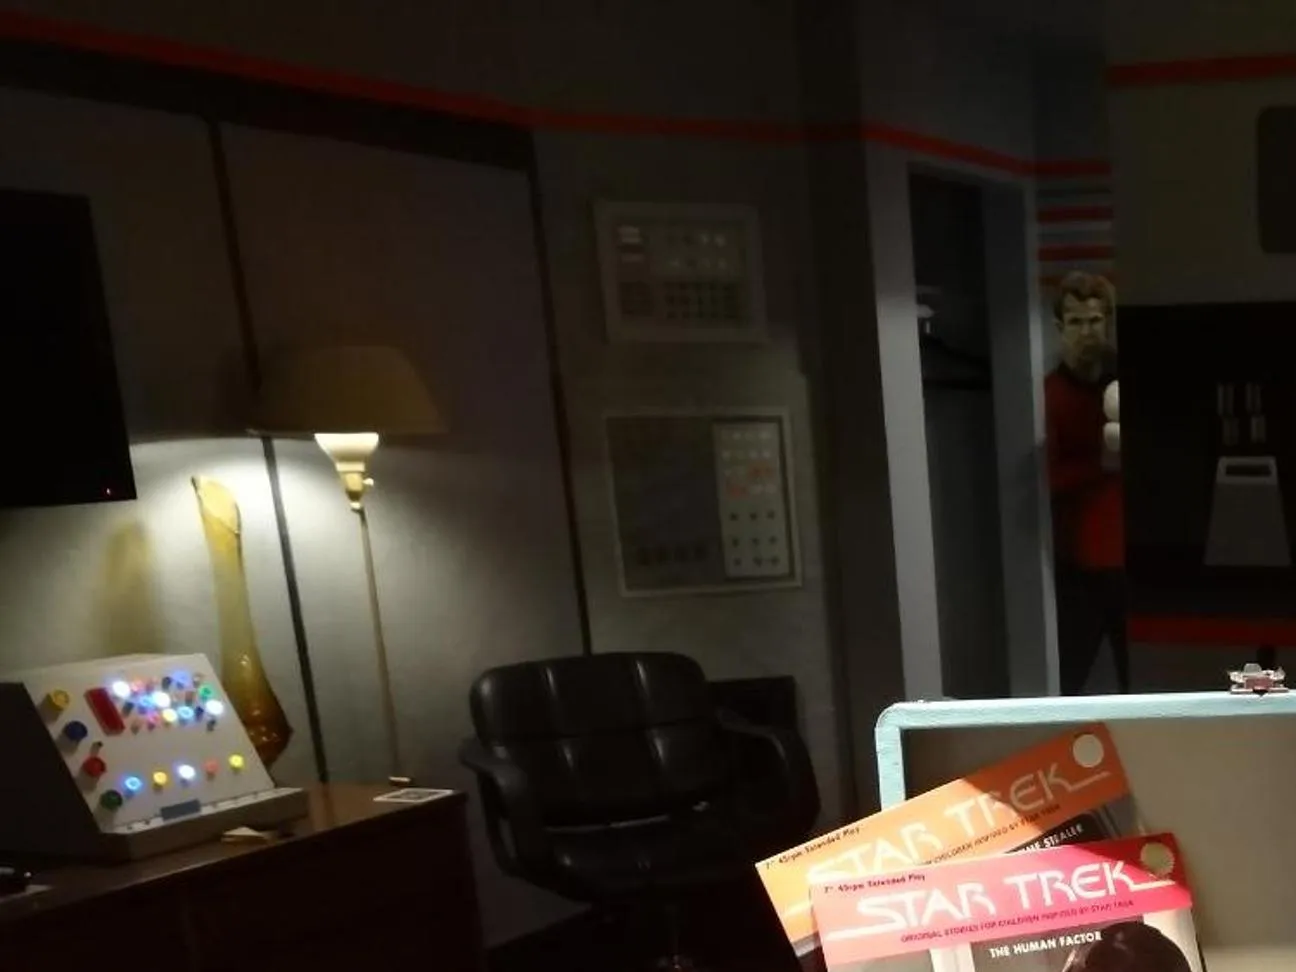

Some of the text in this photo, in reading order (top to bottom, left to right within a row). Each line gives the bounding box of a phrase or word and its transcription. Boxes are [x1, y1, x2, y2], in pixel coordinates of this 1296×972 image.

[944, 761, 1110, 836] TREK
[804, 834, 841, 852] Extended
[843, 825, 860, 839] Play
[867, 875, 906, 888] Extended
[908, 872, 925, 883] Play
[828, 858, 1175, 941] STAR TREK
[989, 931, 1102, 958] THE HUMAN FACTOR
